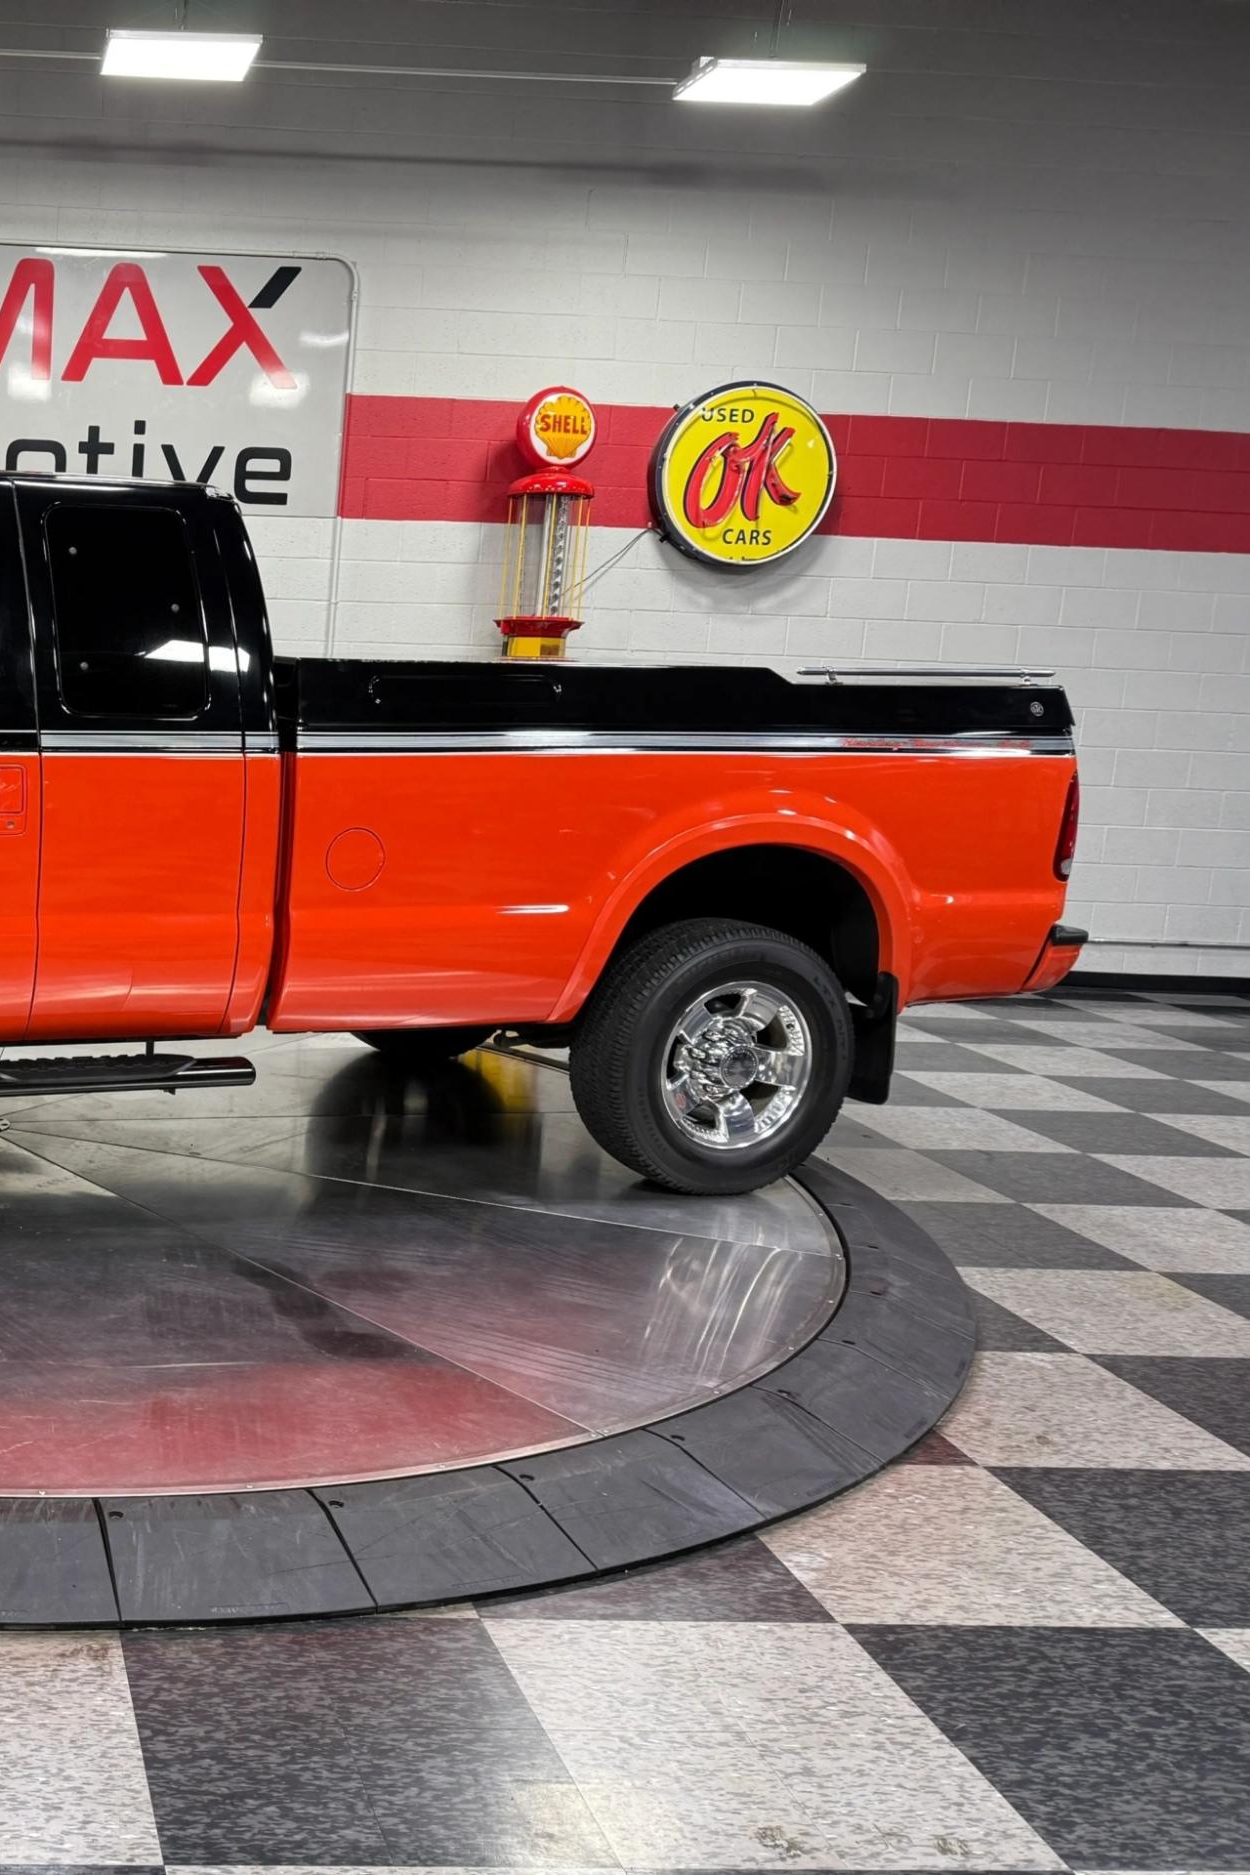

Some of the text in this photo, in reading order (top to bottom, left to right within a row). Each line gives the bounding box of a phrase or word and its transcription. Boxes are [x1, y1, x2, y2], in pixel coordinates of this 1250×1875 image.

[540, 414, 588, 435] SHELL
[701, 408, 755, 423] USED
[683, 412, 802, 529] OK
[722, 528, 772, 546] CARS
